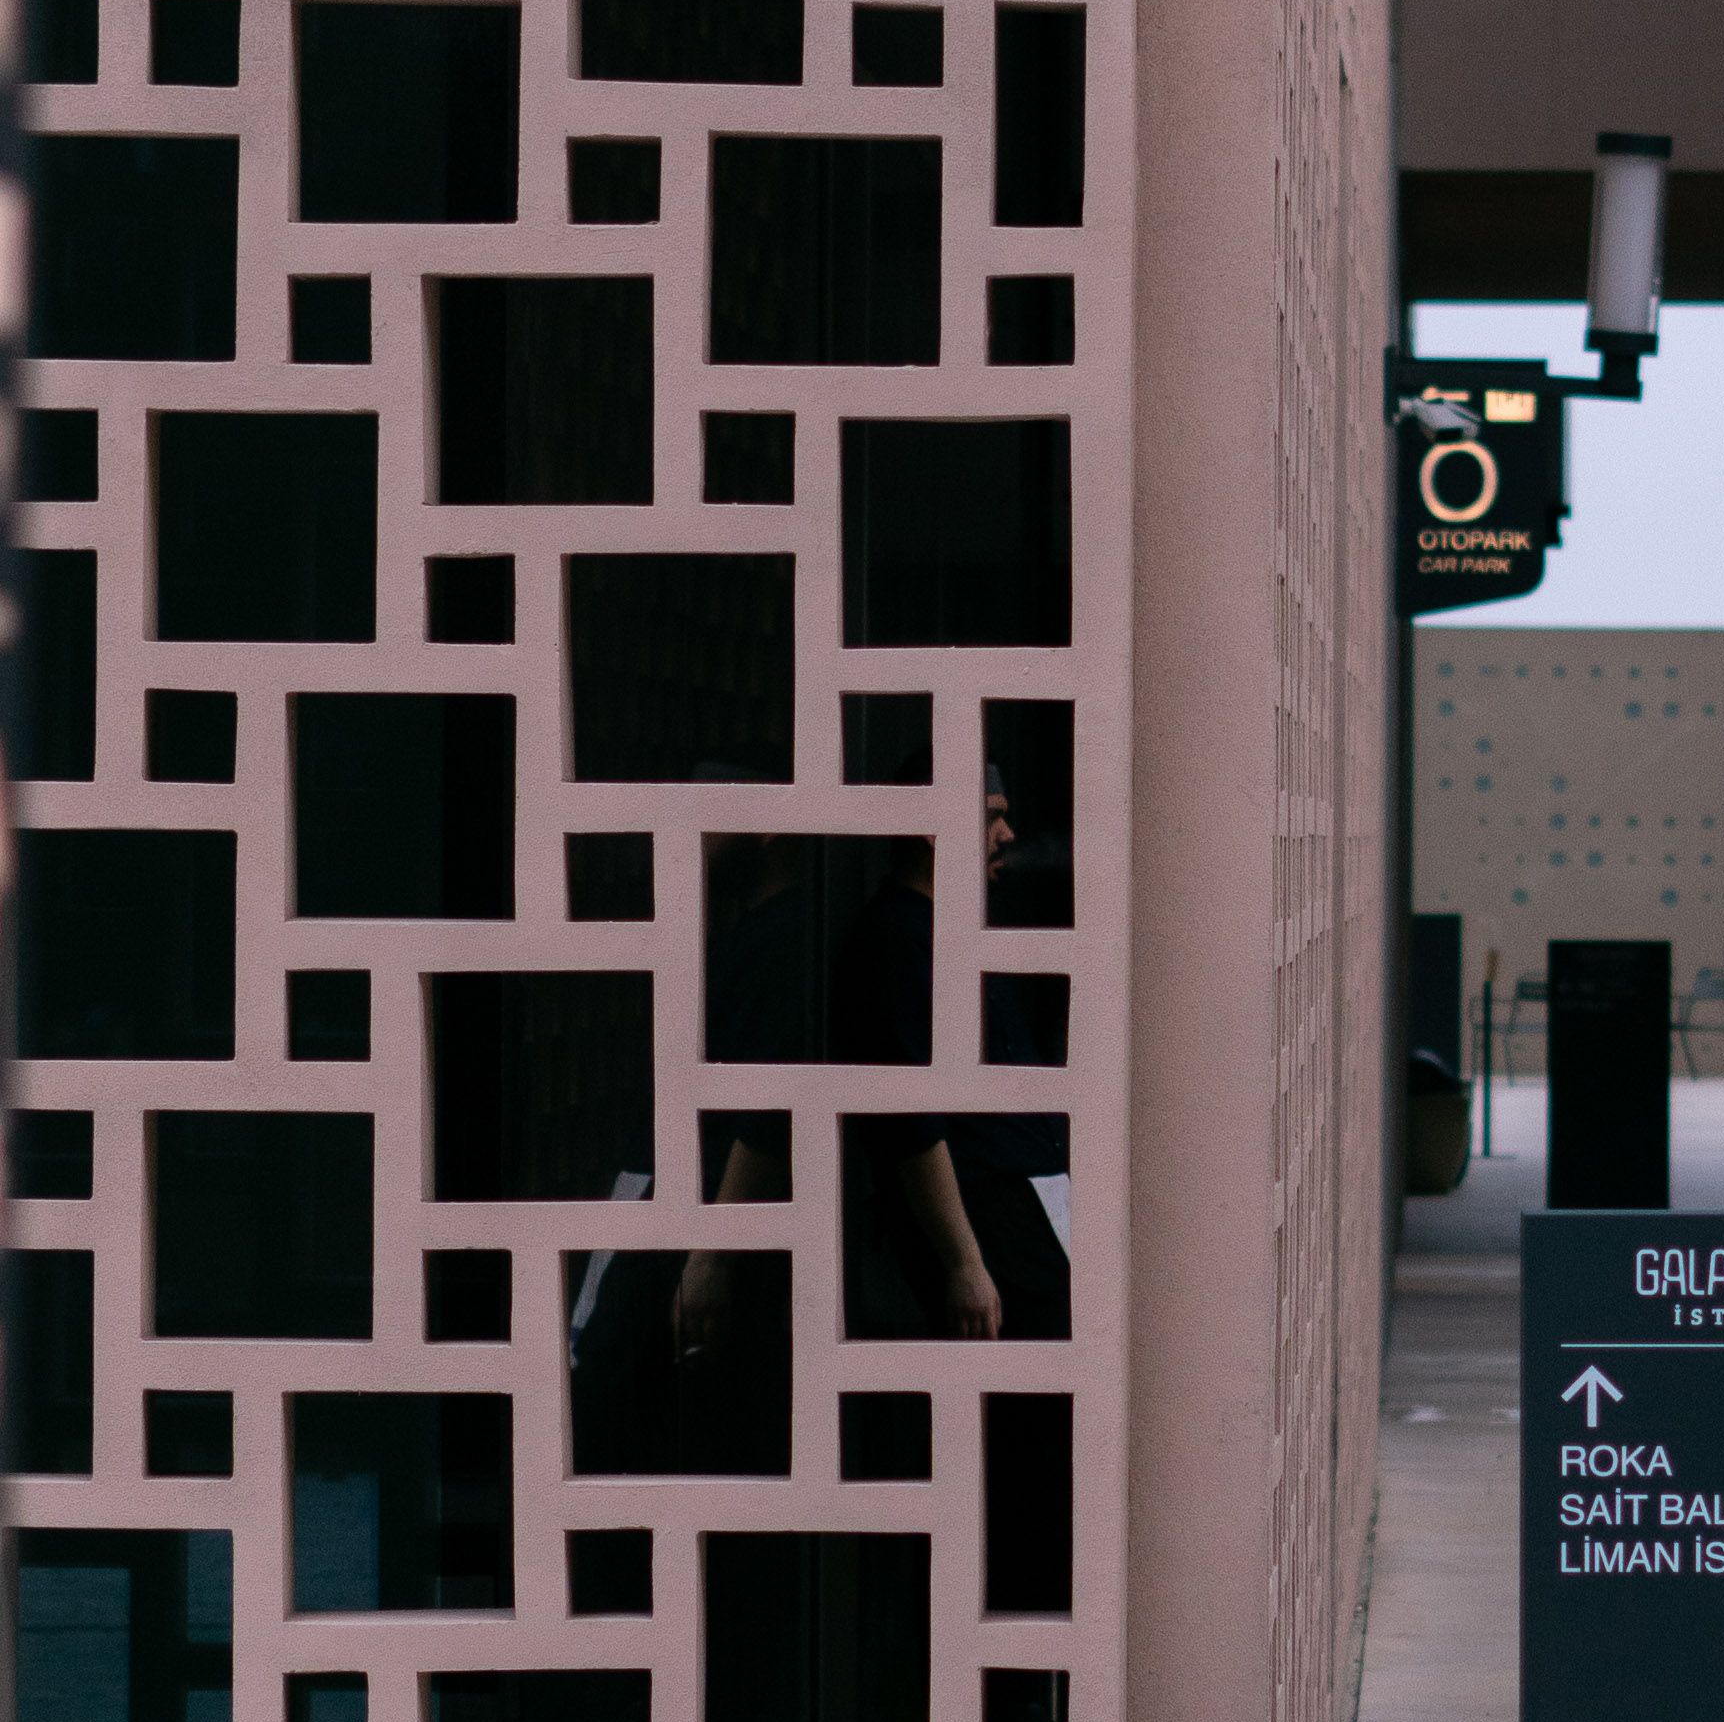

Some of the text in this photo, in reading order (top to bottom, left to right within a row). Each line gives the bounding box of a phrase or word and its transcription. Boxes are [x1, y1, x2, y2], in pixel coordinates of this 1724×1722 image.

[1419, 531, 1530, 550] OTOPARK
[1419, 557, 1510, 573] CAR PARK
[1560, 1444, 1673, 1478] ROKA
[1559, 1487, 1648, 1526] SAİT
[1560, 1535, 1680, 1574] LİMAN
